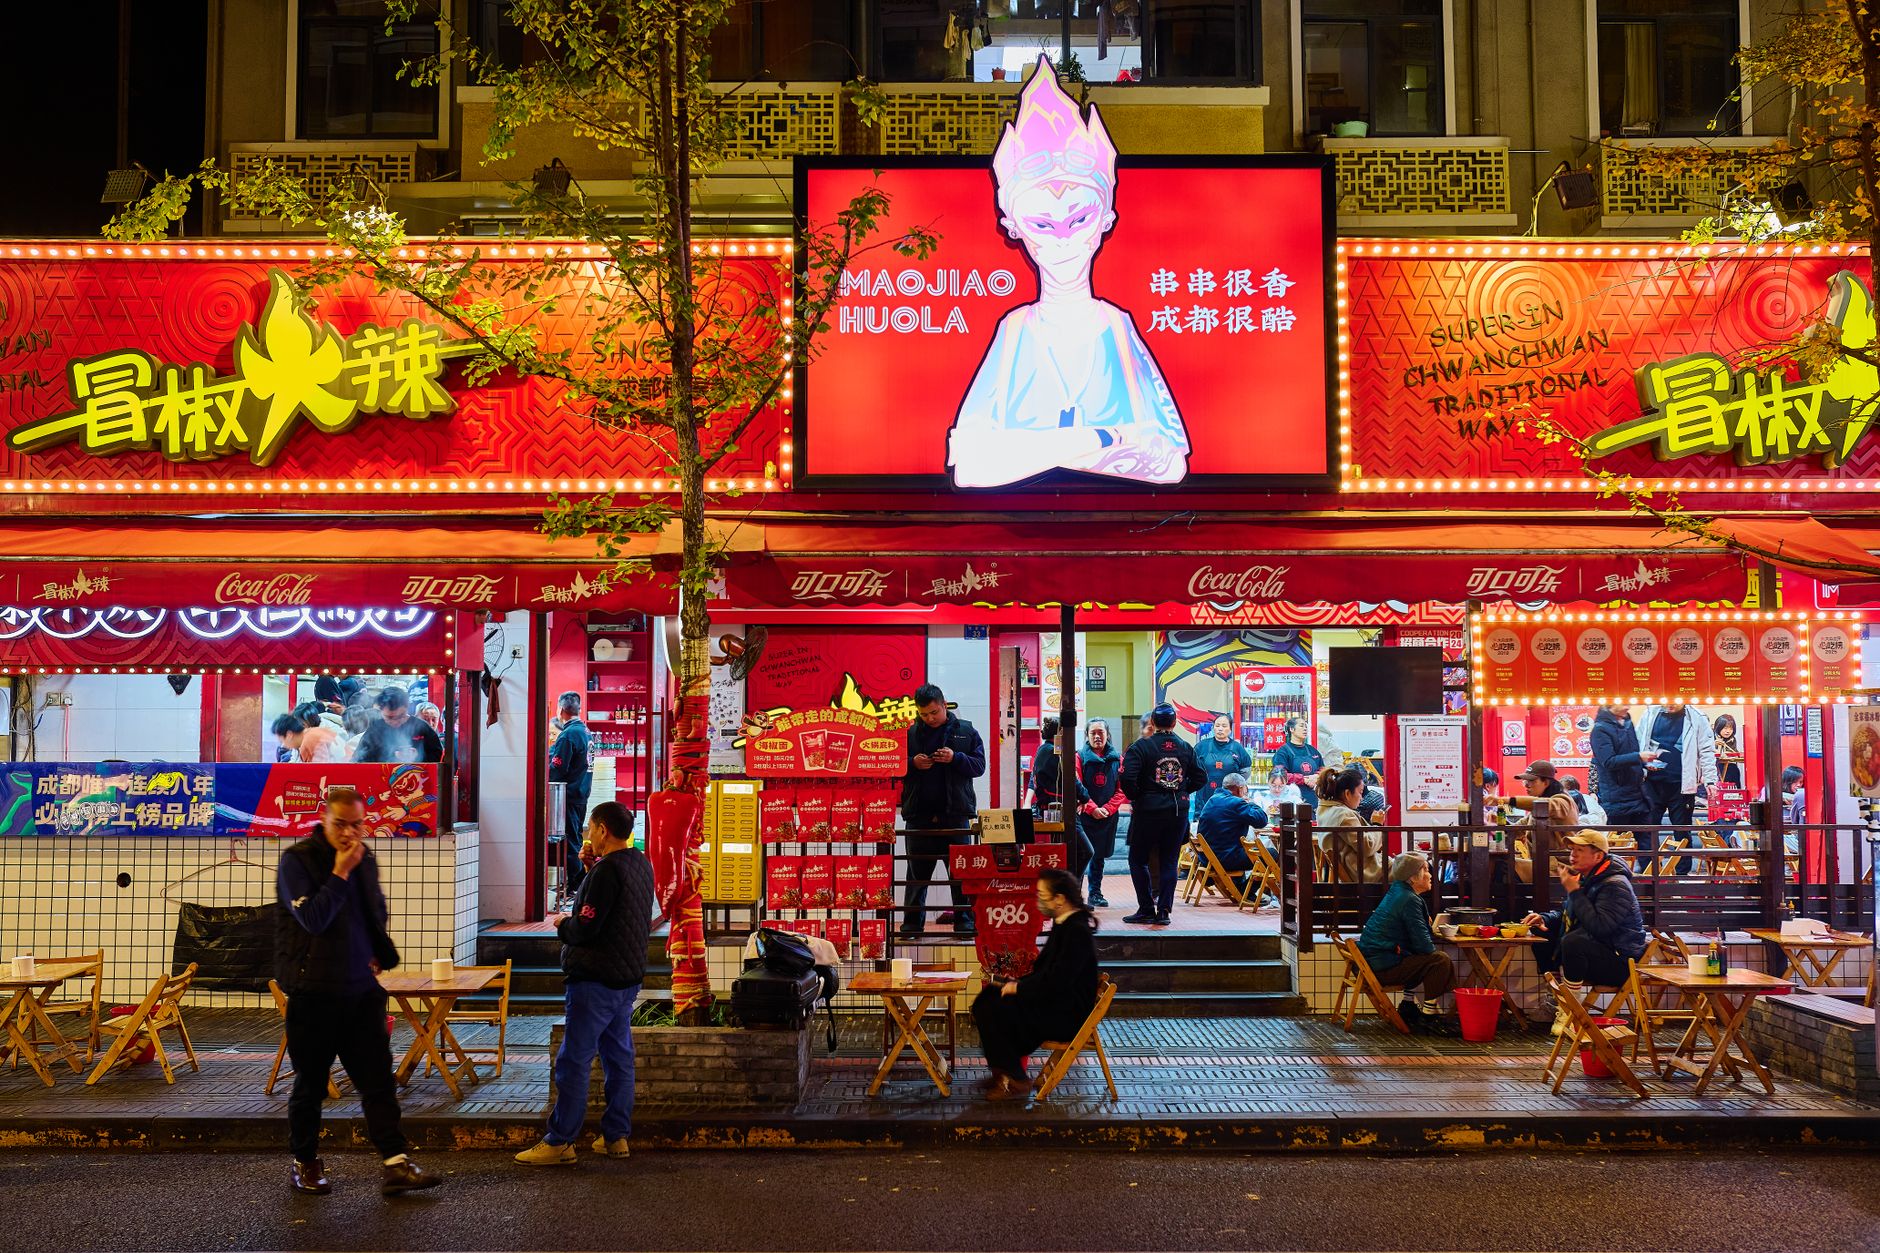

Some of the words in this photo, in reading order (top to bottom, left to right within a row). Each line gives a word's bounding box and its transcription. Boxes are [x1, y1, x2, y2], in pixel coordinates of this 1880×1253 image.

[838, 268, 1017, 297] MAOJIAO
[1149, 267, 1297, 298] 串串很香
[838, 305, 970, 334] HUOLA
[1146, 304, 1297, 334] 成都很酷
[1430, 300, 1563, 347] SUPER-IN
[1404, 328, 1608, 388] CHWANCHWAN
[1428, 368, 1608, 416] TRADITIONAL
[1458, 414, 1515, 441] WAY
[215, 572, 320, 605] Coca-Cola
[402, 575, 504, 604] 可口可乐
[791, 568, 894, 600] 可口可乐
[1187, 565, 1290, 598] Coca-Cola
[1466, 565, 1567, 597] 可口可乐
[862, 740, 897, 750] 火锅底料
[36, 774, 214, 795] 成都唯一连八年
[955, 854, 988, 869] 自助
[1026, 853, 1061, 869] 取号
[986, 903, 1029, 928] 1986
